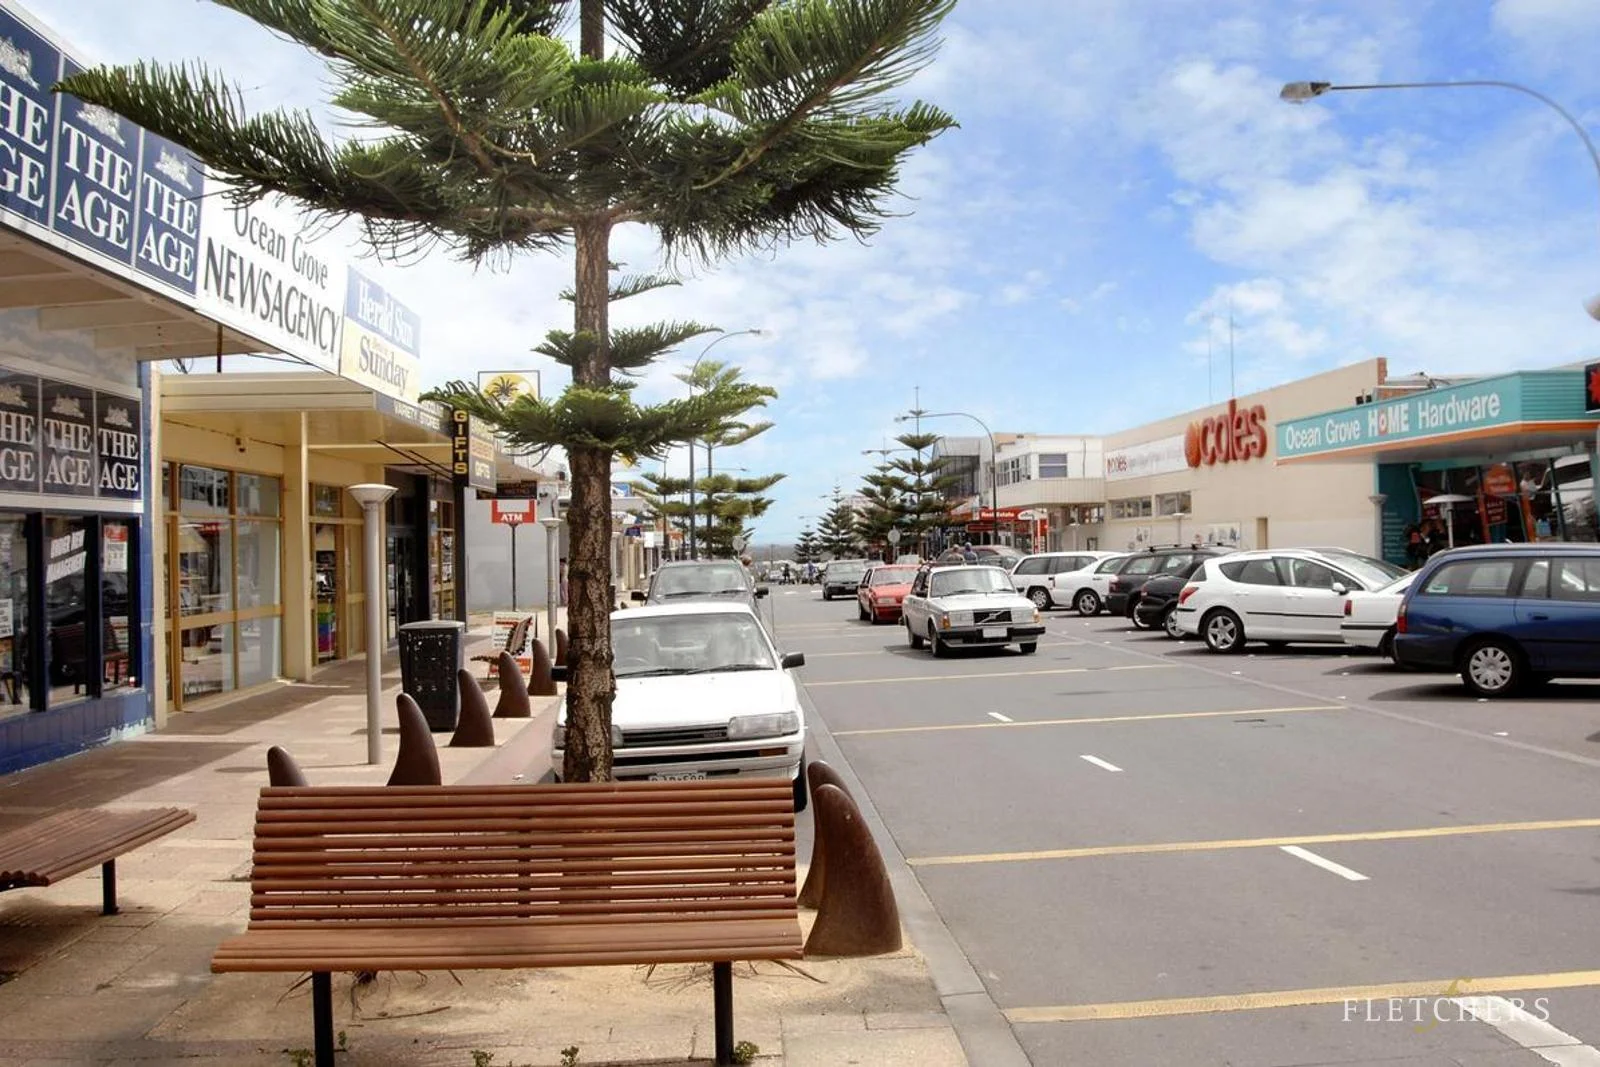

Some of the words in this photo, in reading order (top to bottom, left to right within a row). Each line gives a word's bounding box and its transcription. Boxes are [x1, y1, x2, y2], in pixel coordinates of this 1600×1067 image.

[0, 81, 48, 154] HE
[0, 139, 45, 208] GE
[62, 120, 133, 202] THE
[57, 179, 129, 249] AGE
[143, 172, 198, 240] THE
[138, 223, 194, 282] AGE
[234, 199, 287, 263] Ocean
[292, 236, 329, 290] Grove
[203, 236, 341, 354] NEWSAGENCY
[359, 335, 409, 395] Sunday
[0, 410, 36, 445] HE
[44, 418, 92, 453] THE
[98, 427, 139, 460] THE
[453, 410, 468, 474] GIFTS
[1200, 398, 1268, 467] coles
[1285, 426, 1322, 450] Ocean
[1325, 418, 1361, 444] Grove
[1367, 403, 1410, 437] HOME
[1418, 391, 1501, 429] Hardware
[0, 448, 36, 482] GE
[44, 454, 92, 486] AGE
[99, 461, 139, 492] AGE
[500, 513, 523, 522] ATM
